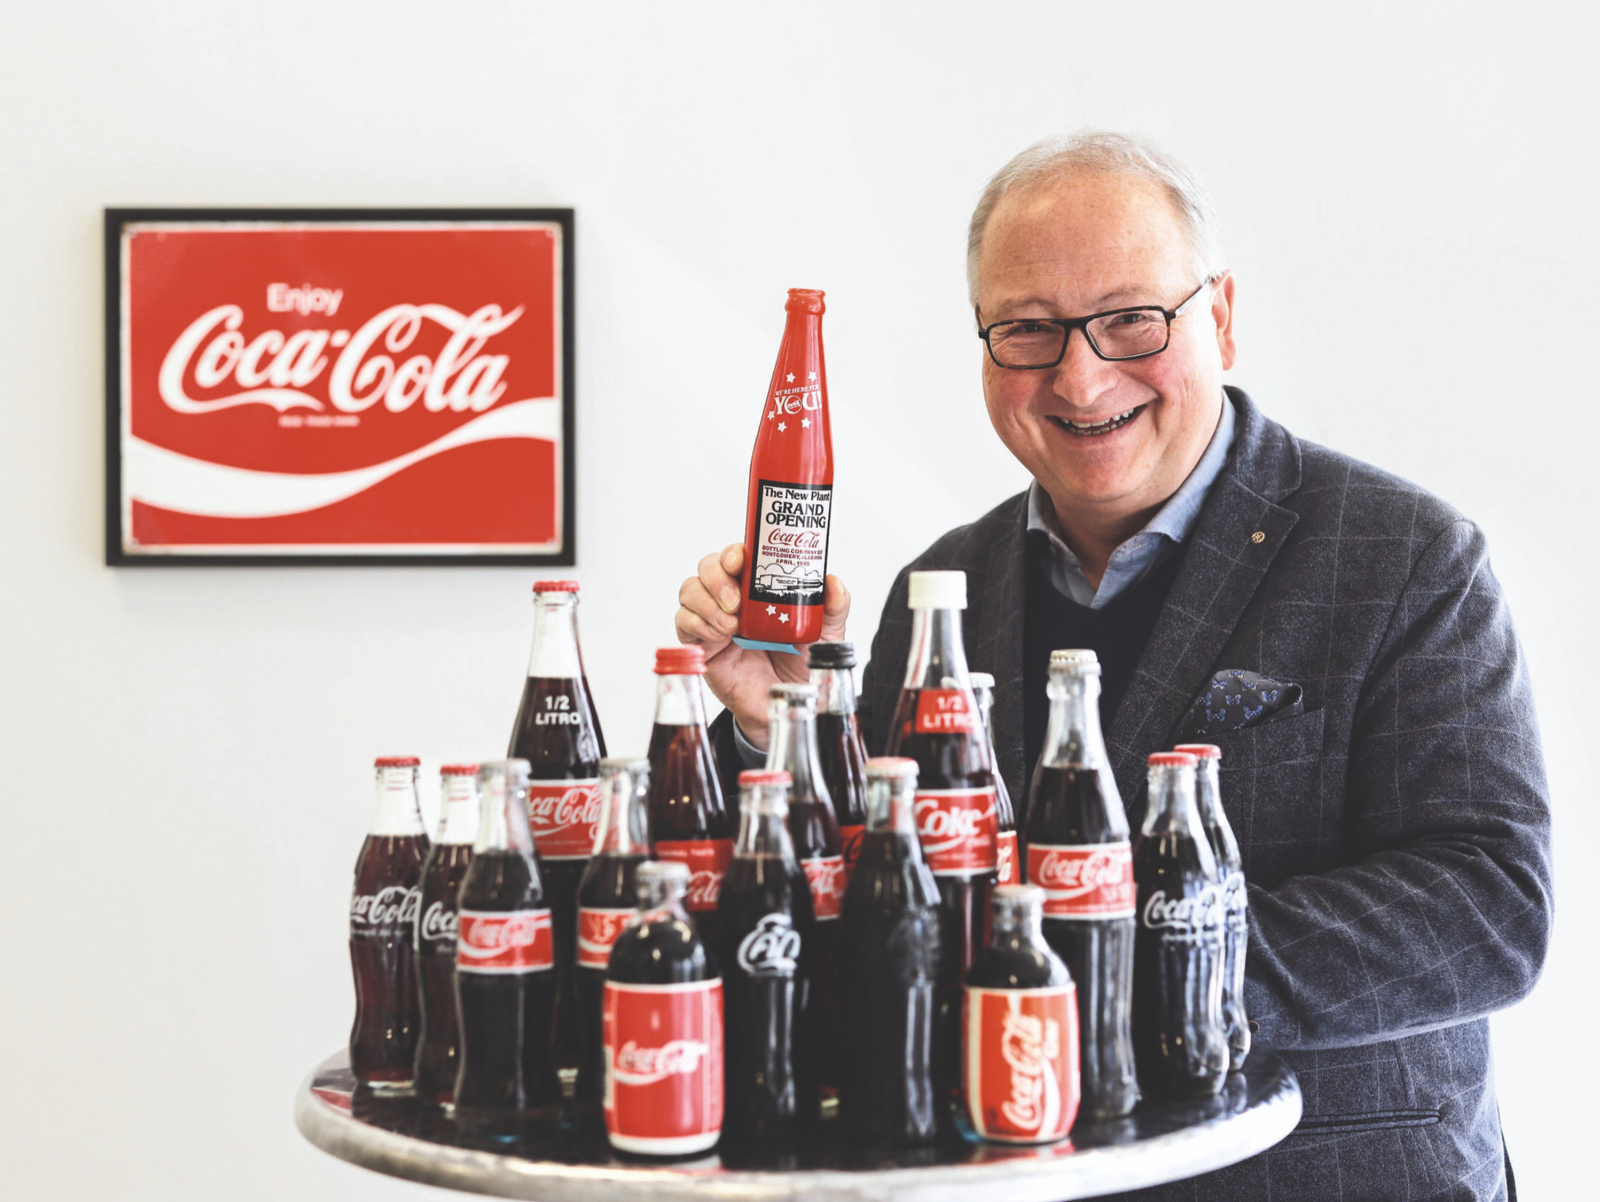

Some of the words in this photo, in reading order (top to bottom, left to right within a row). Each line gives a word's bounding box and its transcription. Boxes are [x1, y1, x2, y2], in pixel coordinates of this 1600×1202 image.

[267, 283, 343, 316] Enjoy
[158, 303, 526, 414] Coca-Cola
[792, 386, 808, 394] HERE
[764, 486, 783, 499] The
[785, 489, 811, 501] New
[810, 491, 830, 501] Plant
[771, 500, 824, 516] GRAND
[765, 512, 826, 529] OPENING
[768, 528, 821, 548] Coca-Cola
[762, 545, 790, 554] BOTTLING
[775, 558, 796, 566] APRIL,
[545, 695, 570, 710] 1/2
[936, 696, 963, 711] 1/2
[535, 712, 581, 725] LITRO
[529, 787, 602, 826] ca-Cola
[351, 885, 421, 925] ca-Cola
